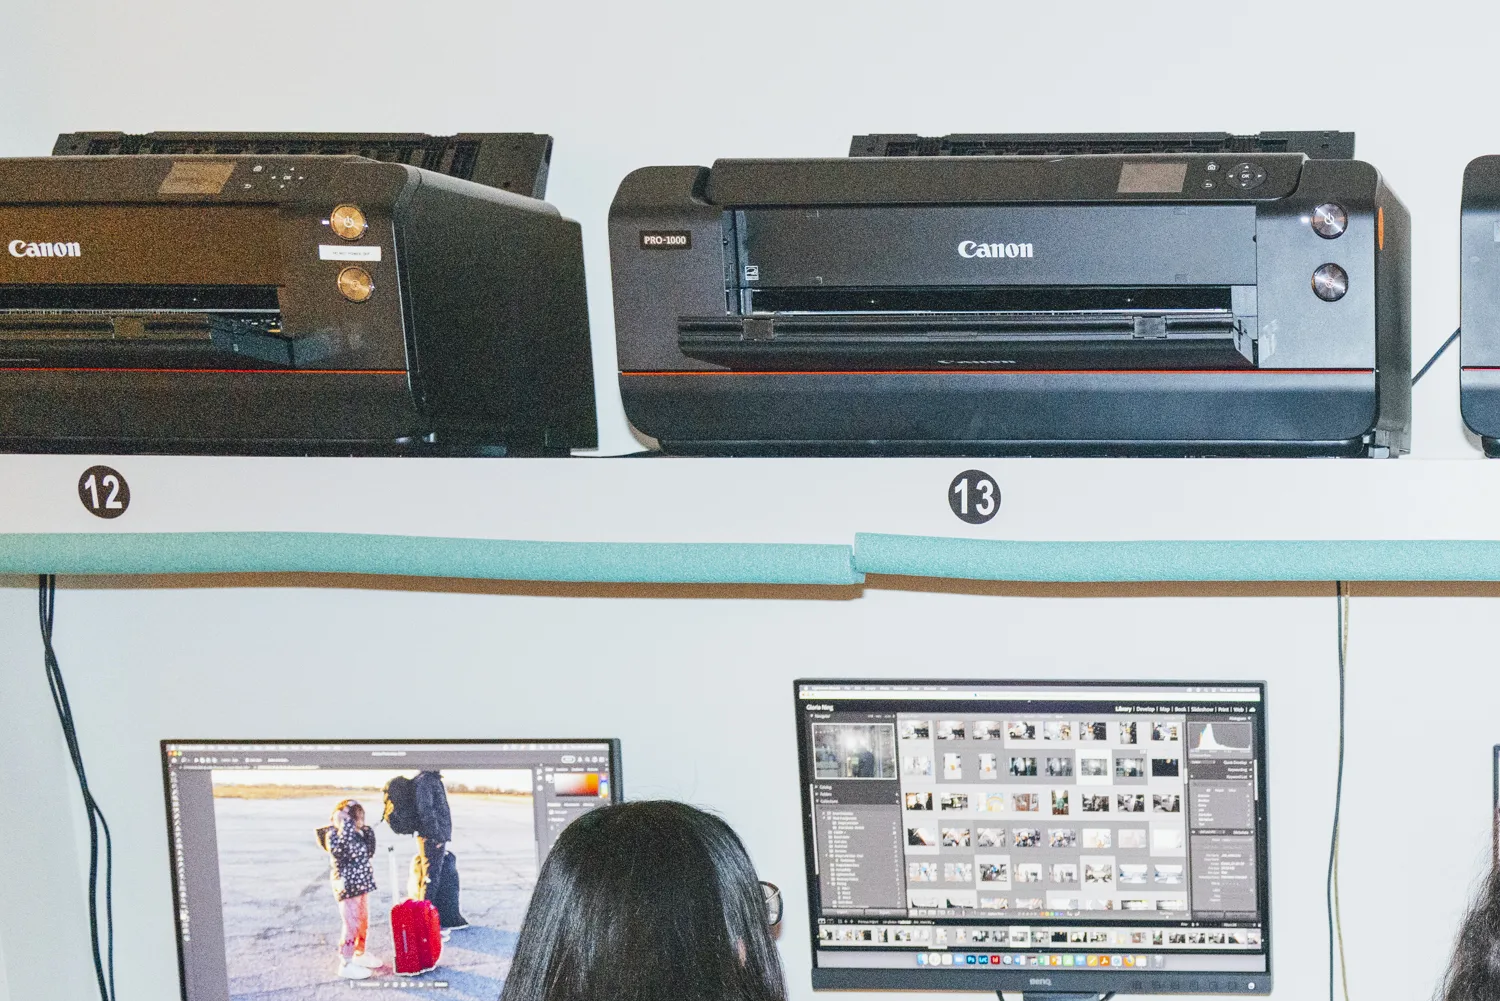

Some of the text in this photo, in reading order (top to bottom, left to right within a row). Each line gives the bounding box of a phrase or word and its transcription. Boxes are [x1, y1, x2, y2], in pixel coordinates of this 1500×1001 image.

[8, 239, 81, 258] Canon
[644, 236, 686, 244] PRO-1000
[958, 240, 1033, 258] Canon
[84, 474, 122, 508] 12
[954, 478, 995, 516] 13
